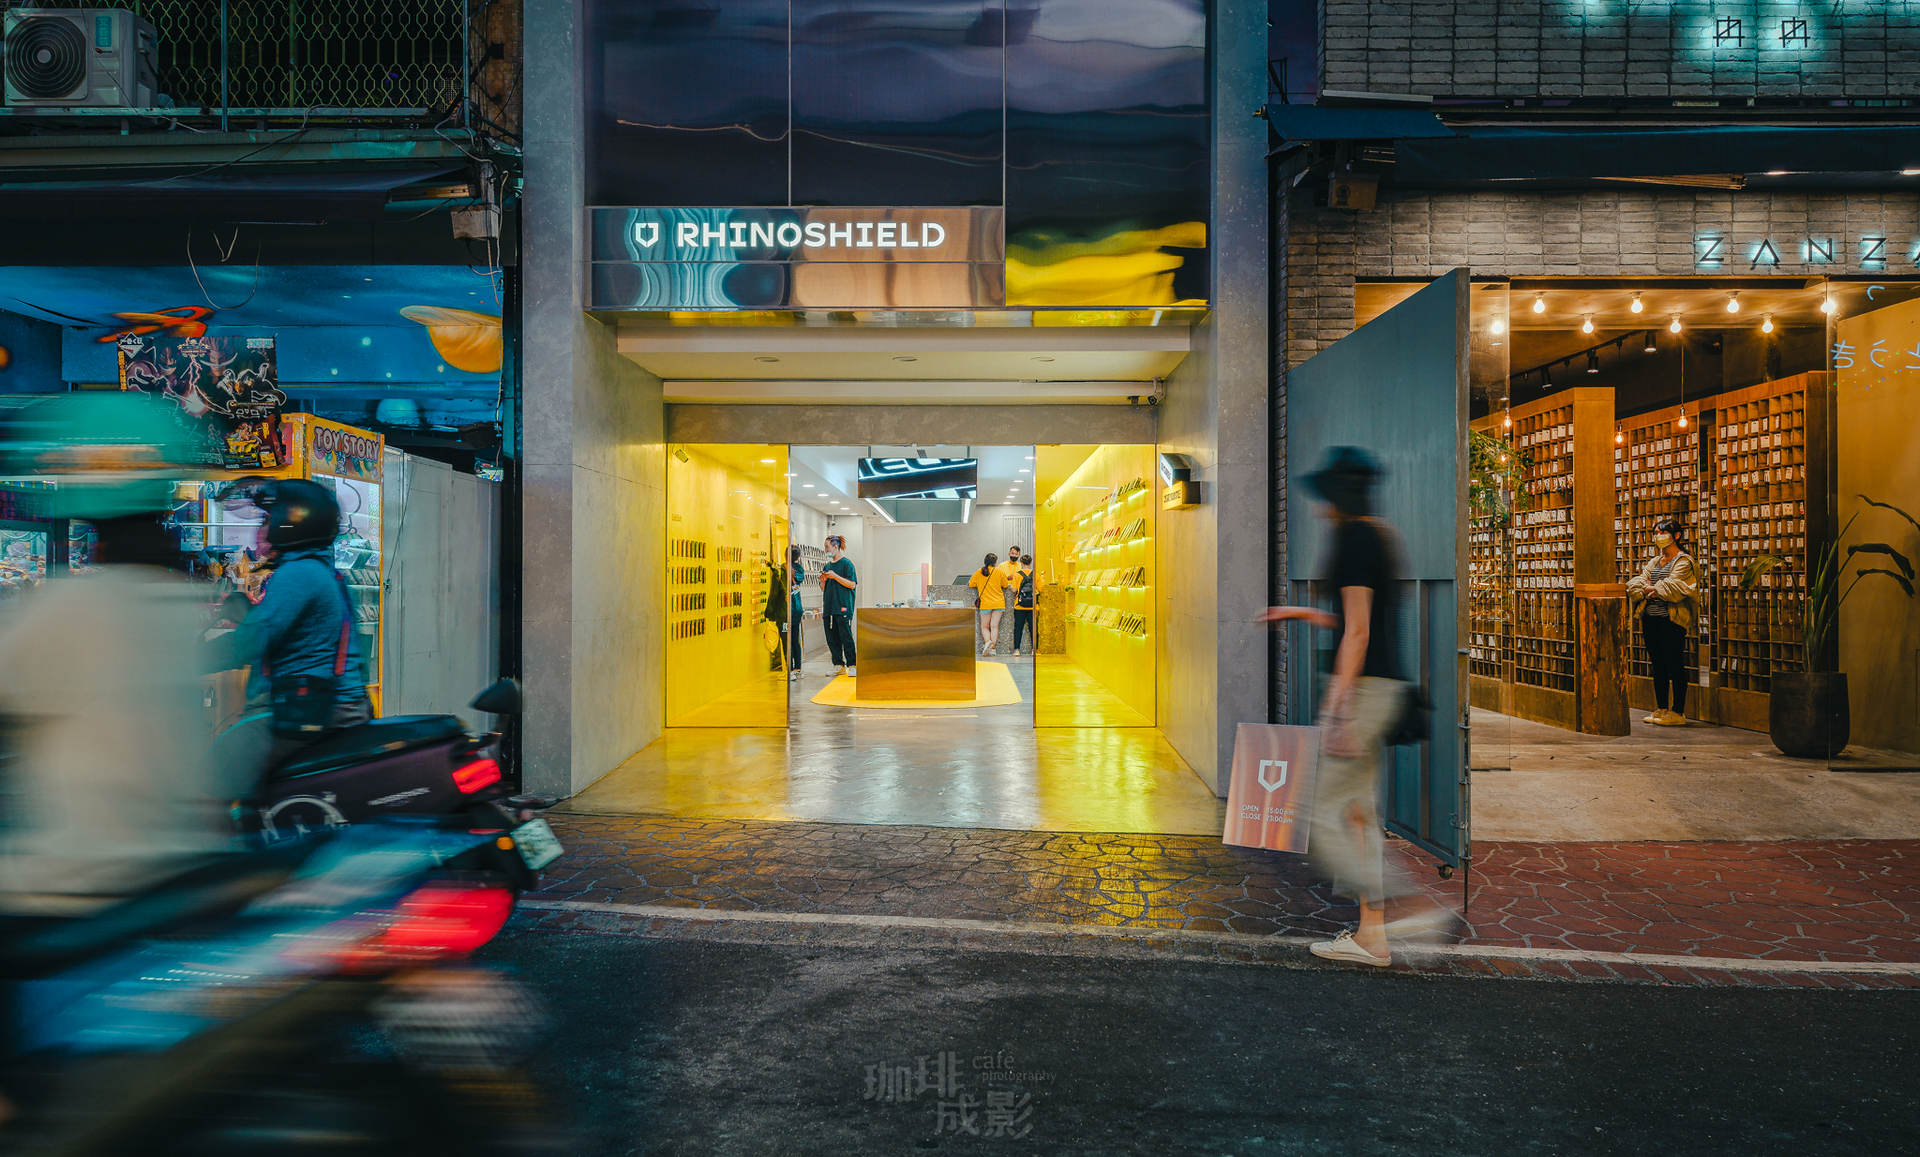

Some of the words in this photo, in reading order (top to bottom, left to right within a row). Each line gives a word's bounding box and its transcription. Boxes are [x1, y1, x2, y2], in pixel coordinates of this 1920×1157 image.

[677, 222, 946, 248] RHINOSHIELD
[314, 425, 341, 453] TOY
[342, 432, 380, 461] STORY
[1240, 804, 1260, 812] OPEN
[1240, 811, 1262, 821] CLOSE
